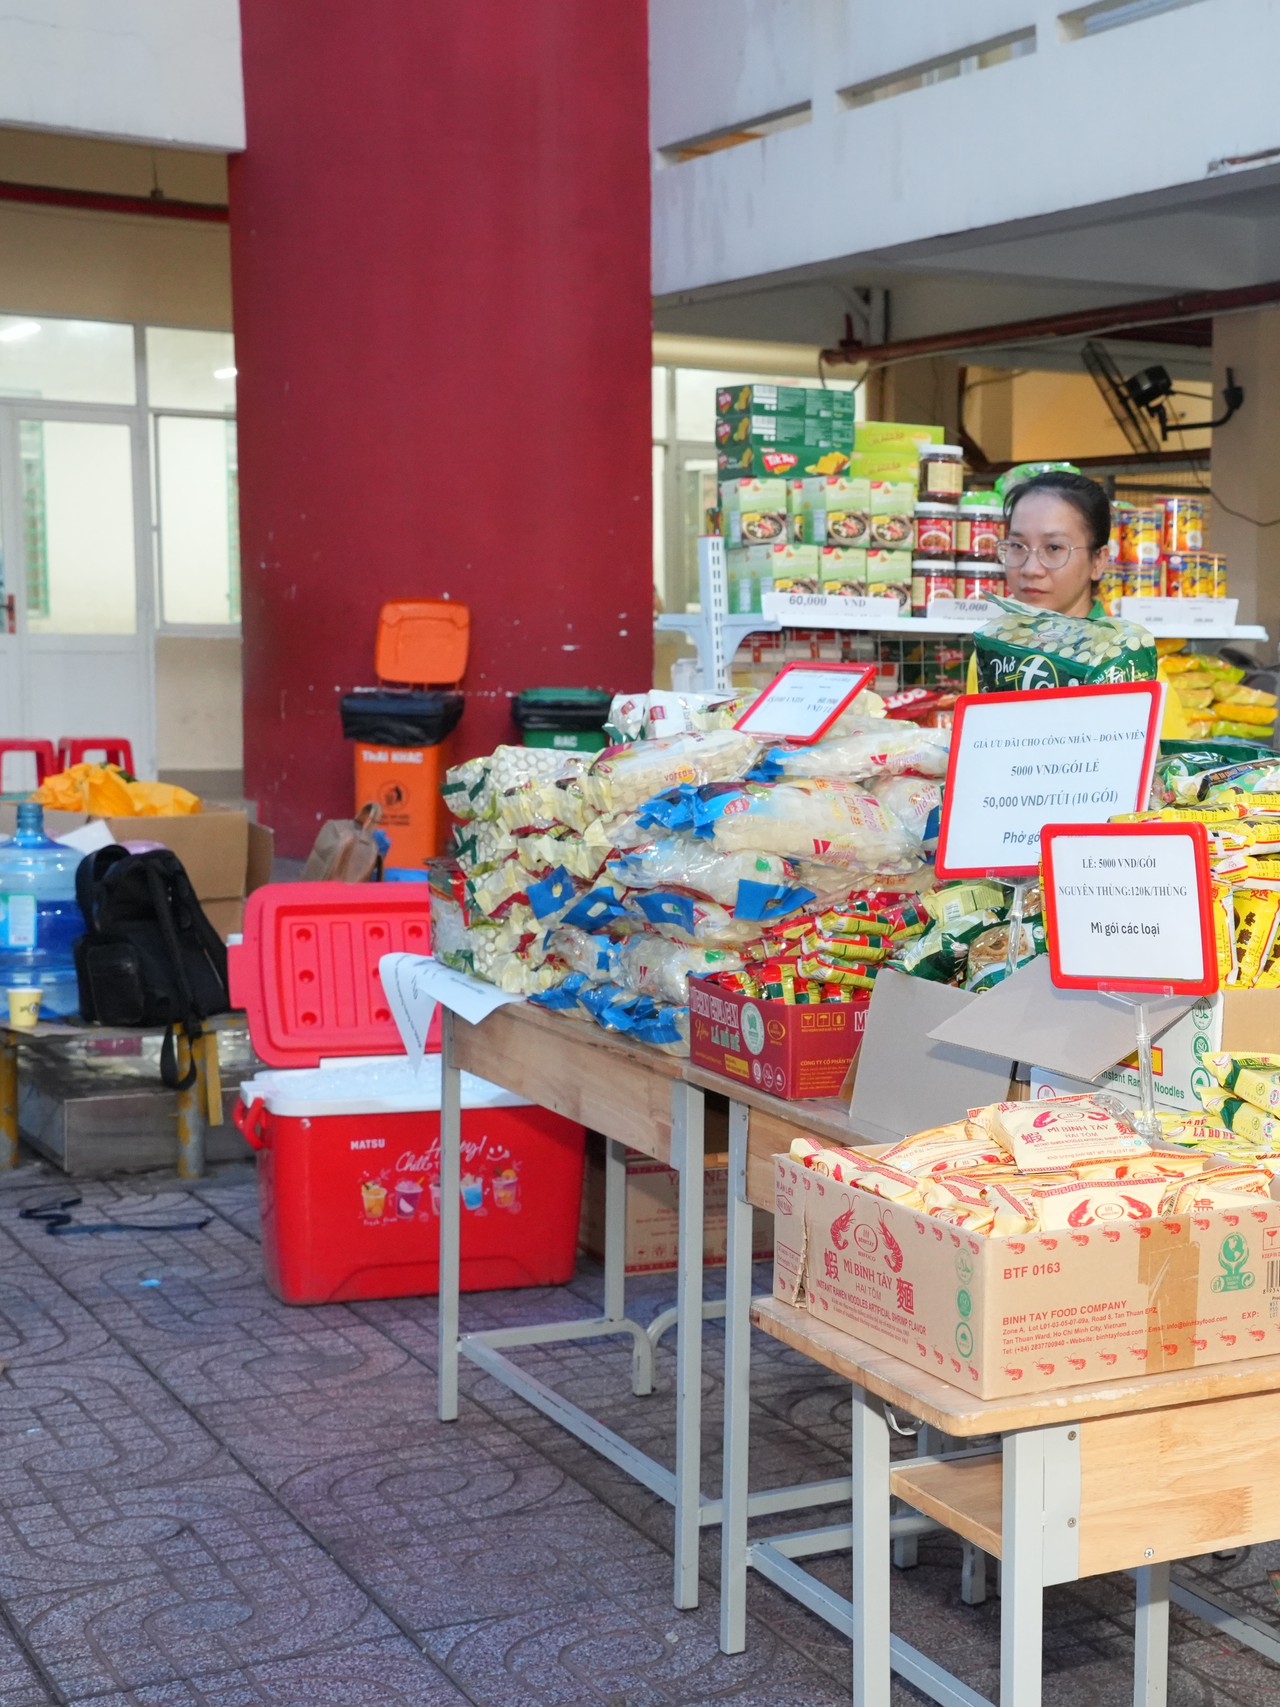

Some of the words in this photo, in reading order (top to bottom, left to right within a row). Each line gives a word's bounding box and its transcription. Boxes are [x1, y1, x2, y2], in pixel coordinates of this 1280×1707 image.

[789, 595, 827, 607] 60,000
[843, 598, 866, 608] VND
[954, 601, 988, 612] 70,000
[973, 739, 988, 749] GIÁ
[1021, 737, 1040, 747] CHO
[1041, 735, 1066, 746] CÔNG
[1067, 733, 1092, 745] NHÂN
[1099, 731, 1124, 743] ĐOÀN
[1125, 729, 1146, 740] VIÊN
[1011, 765, 1033, 777] 5000
[1035, 760, 1084, 776] VND/GÓI
[982, 795, 1019, 810] 50,000
[1021, 790, 1070, 807] VND/TÚI
[1072, 791, 1089, 807] (10
[1091, 788, 1118, 804] GÓI)
[1002, 829, 1026, 844] Phở
[1027, 830, 1041, 846] gó
[1098, 858, 1116, 869] 5000
[1117, 855, 1156, 869] VND/GÓI
[1058, 883, 1095, 897] NGUYÊN
[1090, 921, 1103, 934] Mì
[1105, 922, 1120, 937] gói
[1121, 923, 1139, 935] các
[1140, 922, 1161, 938] loại
[1154, 1081, 1185, 1100] Noodles
[350, 1138, 386, 1151] MATSU
[395, 1151, 433, 1173] Chill
[843, 1259, 854, 1275] MÌ
[854, 1261, 875, 1281] BÌNH
[876, 1271, 893, 1290] TÂY
[1003, 1266, 1029, 1280] BTF
[1032, 1261, 1061, 1277] 0163
[855, 1282, 866, 1294] HAI
[866, 1286, 882, 1301] TÔM
[896, 1276, 915, 1315] 麵
[816, 1279, 833, 1294] INSTANT
[832, 1285, 848, 1301] RAMEN
[847, 1292, 868, 1310] NOODLES
[868, 1301, 891, 1320] ARTIFICIAL
[891, 1311, 908, 1328] SHRIMP
[908, 1319, 927, 1337] FLAVOR
[1002, 1314, 1027, 1326] BINH
[1029, 1311, 1049, 1323] TAY
[1051, 1307, 1077, 1319] FOOD
[1080, 1299, 1127, 1316] COMPANY
[1241, 1310, 1260, 1320] EXP:
[1002, 1327, 1018, 1336] Zone
[1028, 1324, 1039, 1333] Lot
[1091, 1313, 1106, 1323] Road
[1114, 1311, 1125, 1319] Tan
[1126, 1308, 1144, 1318] Thuan
[1002, 1337, 1014, 1346] Tan
[1014, 1335, 1032, 1344] Thuan
[1053, 1330, 1062, 1338] Ho
[1063, 1328, 1073, 1337] Chi
[1074, 1326, 1088, 1335] Minh
[1103, 1321, 1127, 1331] Vietnam
[1069, 1335, 1096, 1345] Website:
[1096, 1328, 1144, 1342] binhtayfood.com
